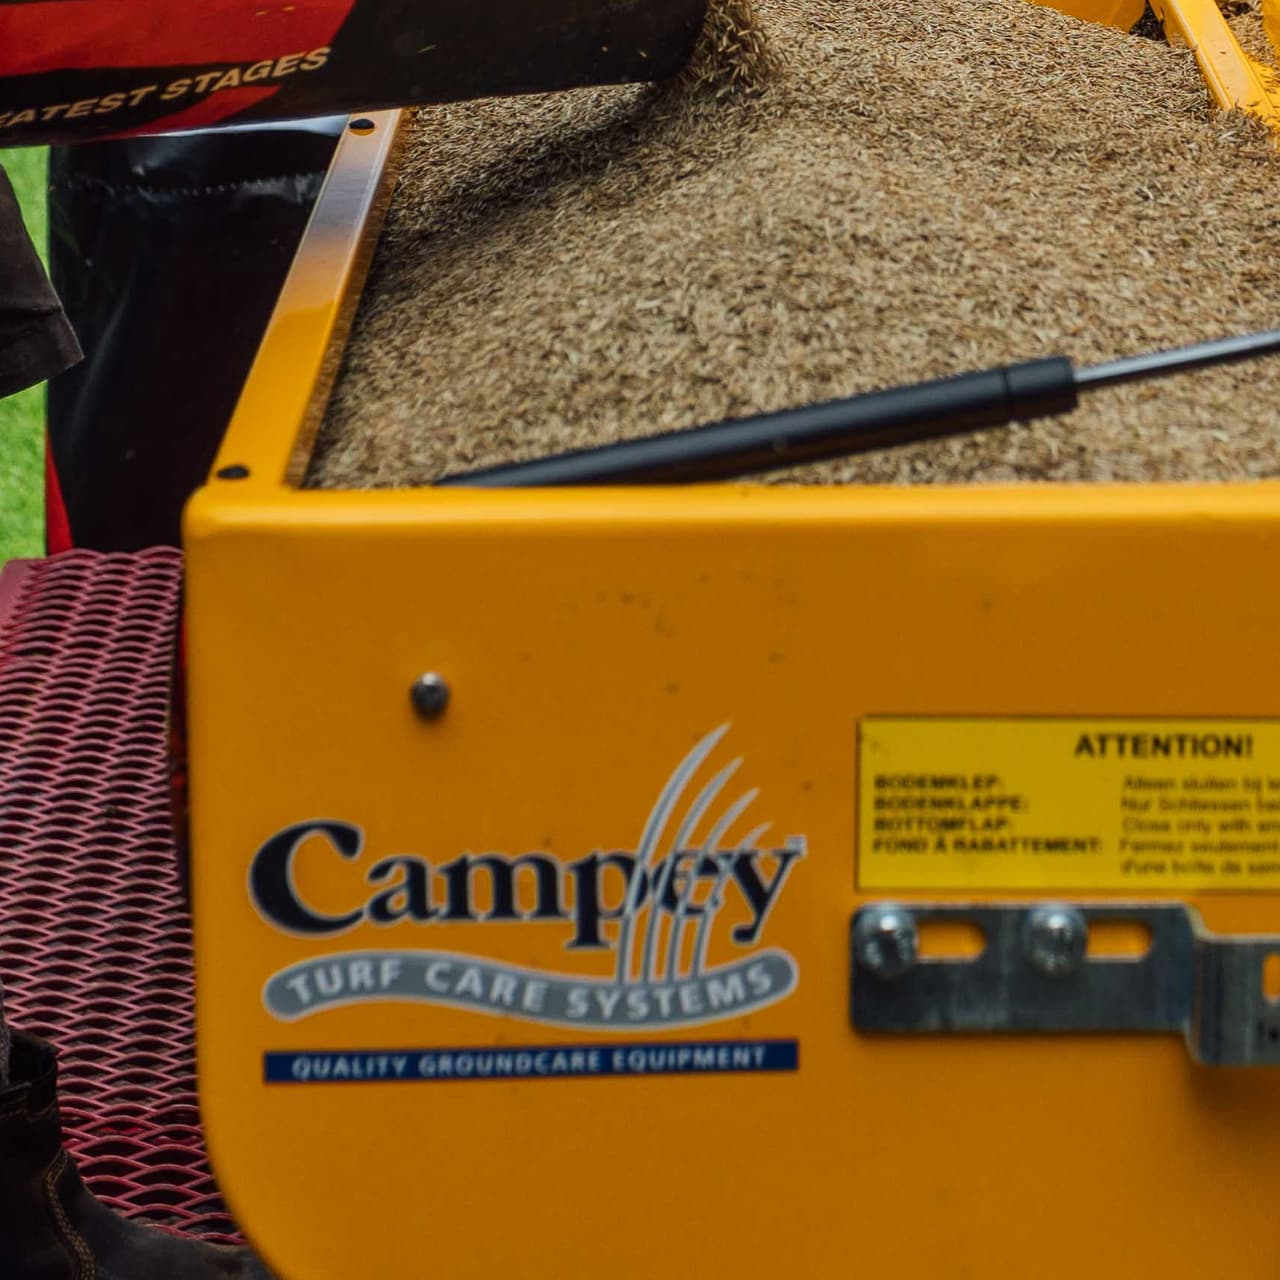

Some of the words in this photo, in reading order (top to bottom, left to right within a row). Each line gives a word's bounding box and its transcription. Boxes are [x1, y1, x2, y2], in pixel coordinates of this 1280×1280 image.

[161, 45, 332, 101] STAGES
[1075, 733, 1254, 759] ATTENTION!
[248, 819, 796, 949] Campey
[287, 958, 402, 1007] TURF
[424, 959, 546, 1014] CARE
[566, 961, 774, 1020] SYSTEMS
[292, 1055, 410, 1081] QUALITY
[417, 1050, 602, 1078] GROUNDCARE
[612, 1045, 767, 1072] EQUIPMENT
